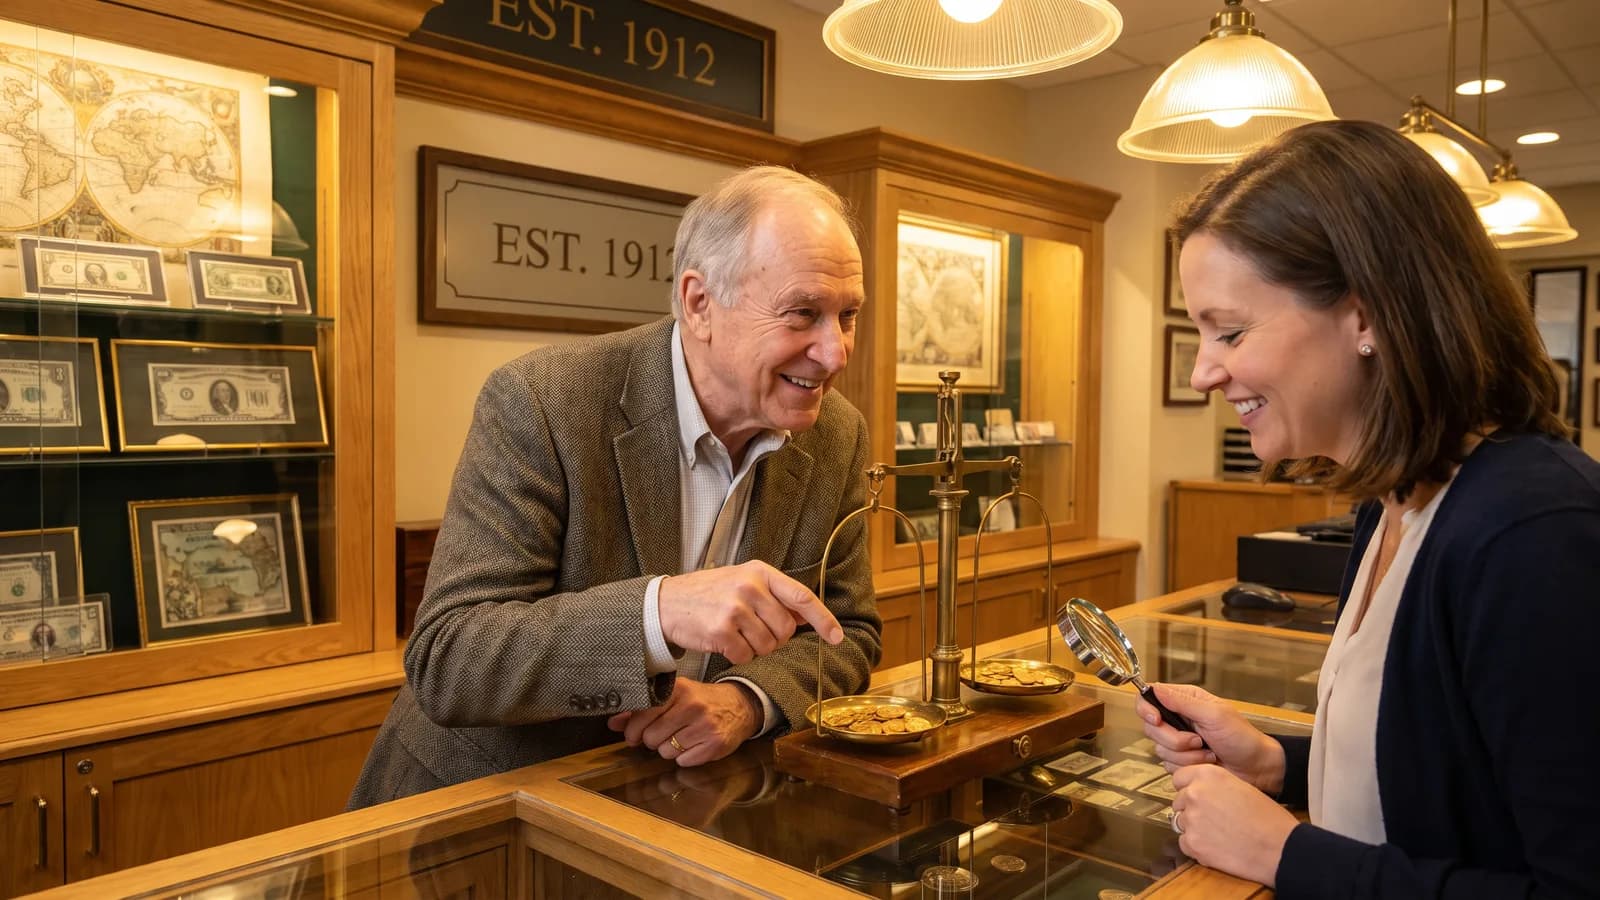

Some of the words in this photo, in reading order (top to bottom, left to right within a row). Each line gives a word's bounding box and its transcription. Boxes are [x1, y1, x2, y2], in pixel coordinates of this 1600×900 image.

[488, 0, 601, 56] EST.
[624, 21, 717, 86] 1912
[493, 222, 587, 275] EST.
